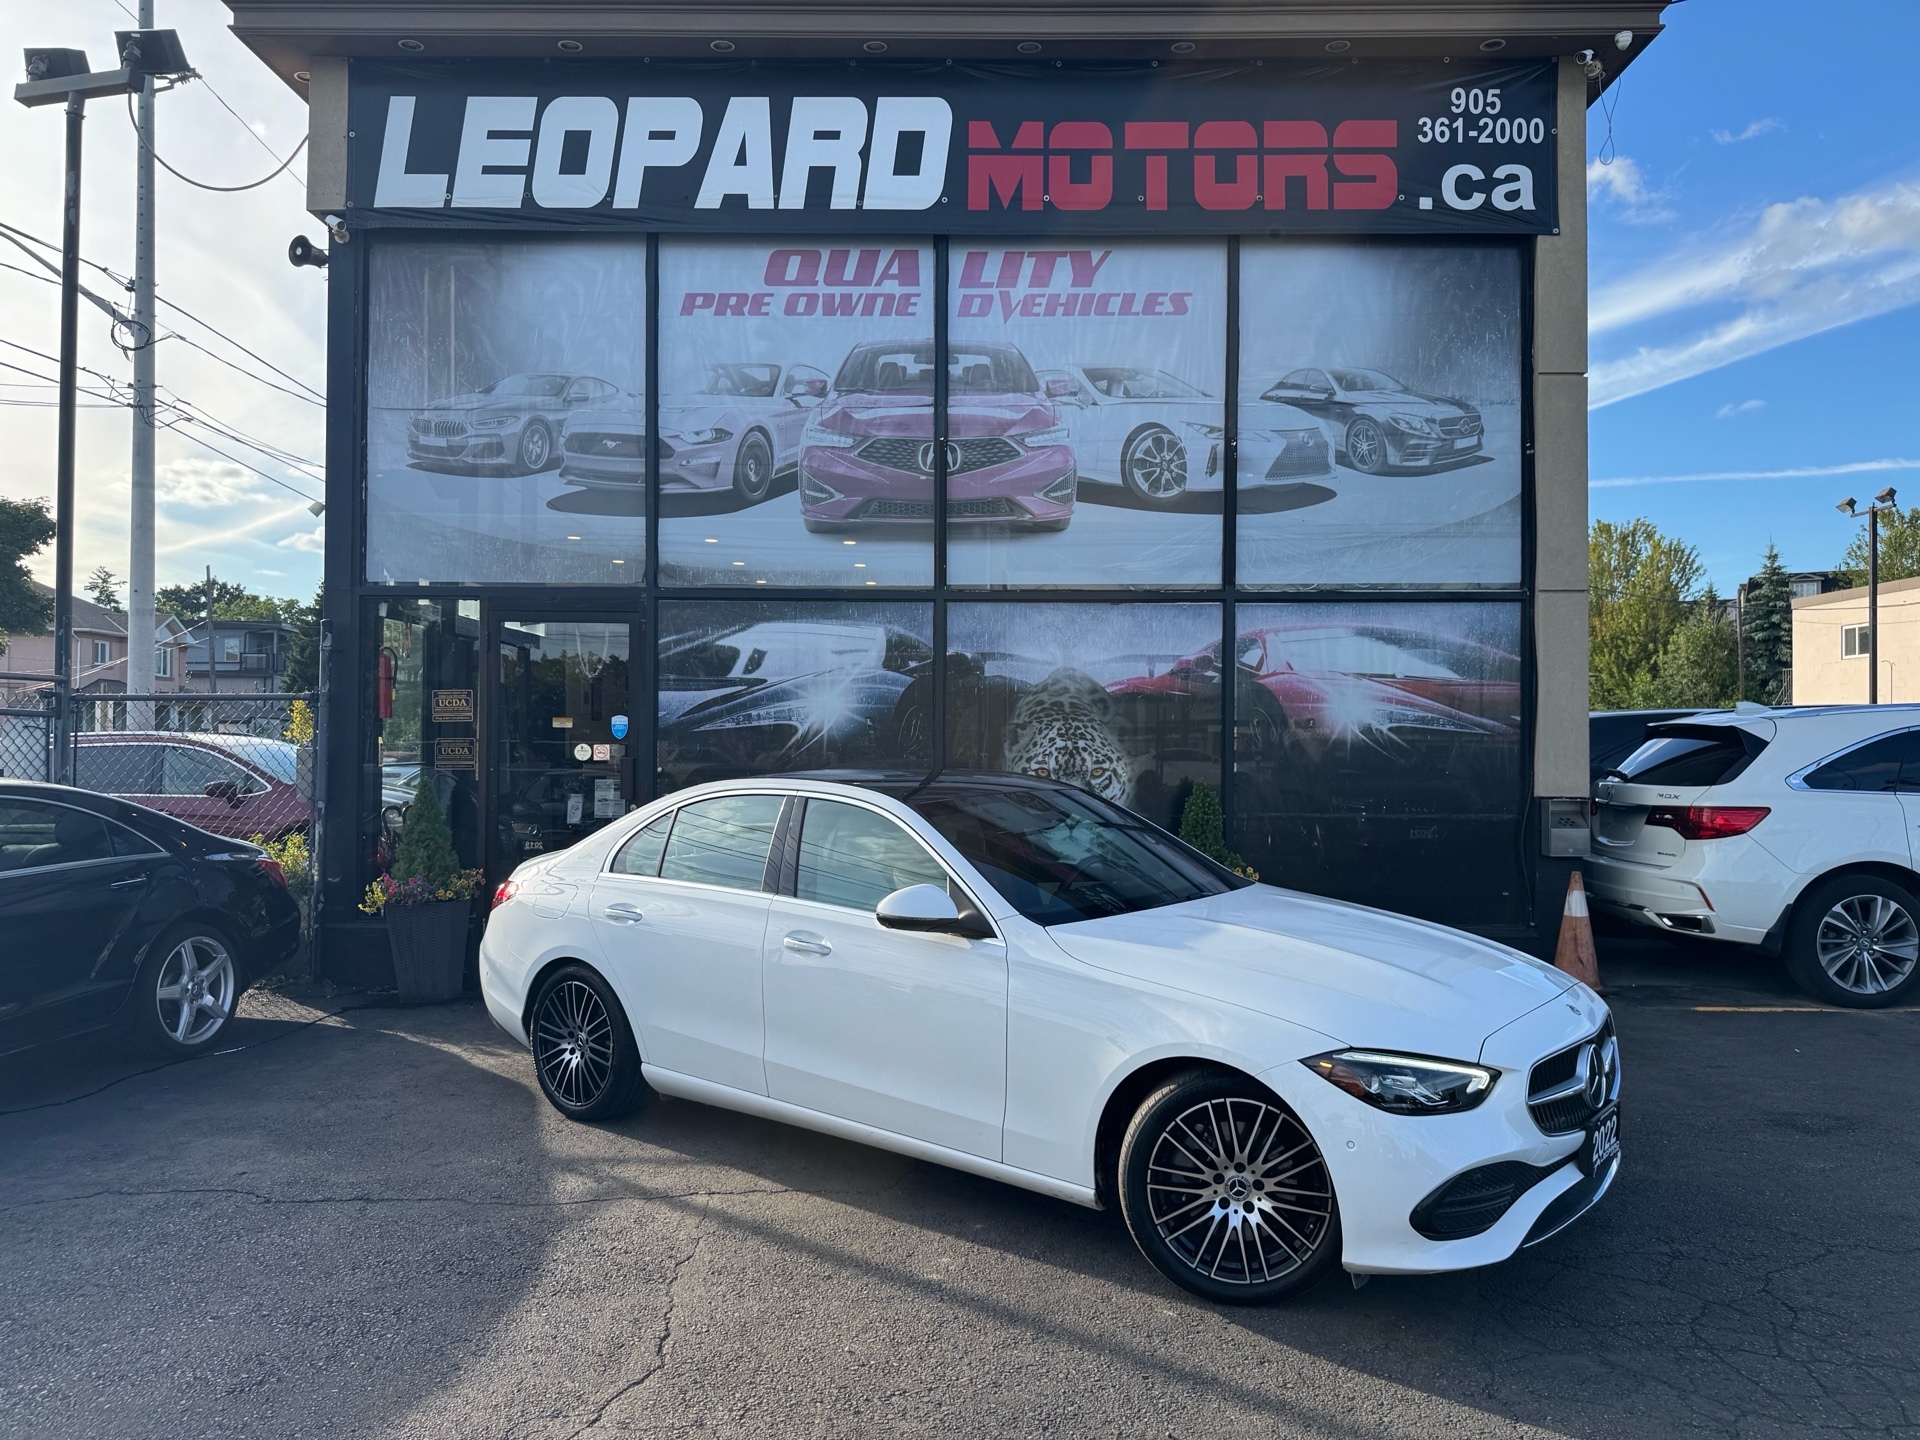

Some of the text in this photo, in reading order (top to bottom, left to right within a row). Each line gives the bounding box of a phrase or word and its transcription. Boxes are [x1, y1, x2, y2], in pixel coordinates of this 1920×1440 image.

[1450, 87, 1502, 115] 905
[1416, 116, 1545, 145] 361-2000
[373, 96, 1398, 211] LEOPARD MOTORS
[1418, 163, 1536, 211] .ca
[680, 292, 770, 317] PRE
[438, 698, 467, 707] UCDA
[441, 747, 470, 755] UCDA
[1656, 792, 1682, 800] MDX
[1593, 1114, 1617, 1163] 2022
